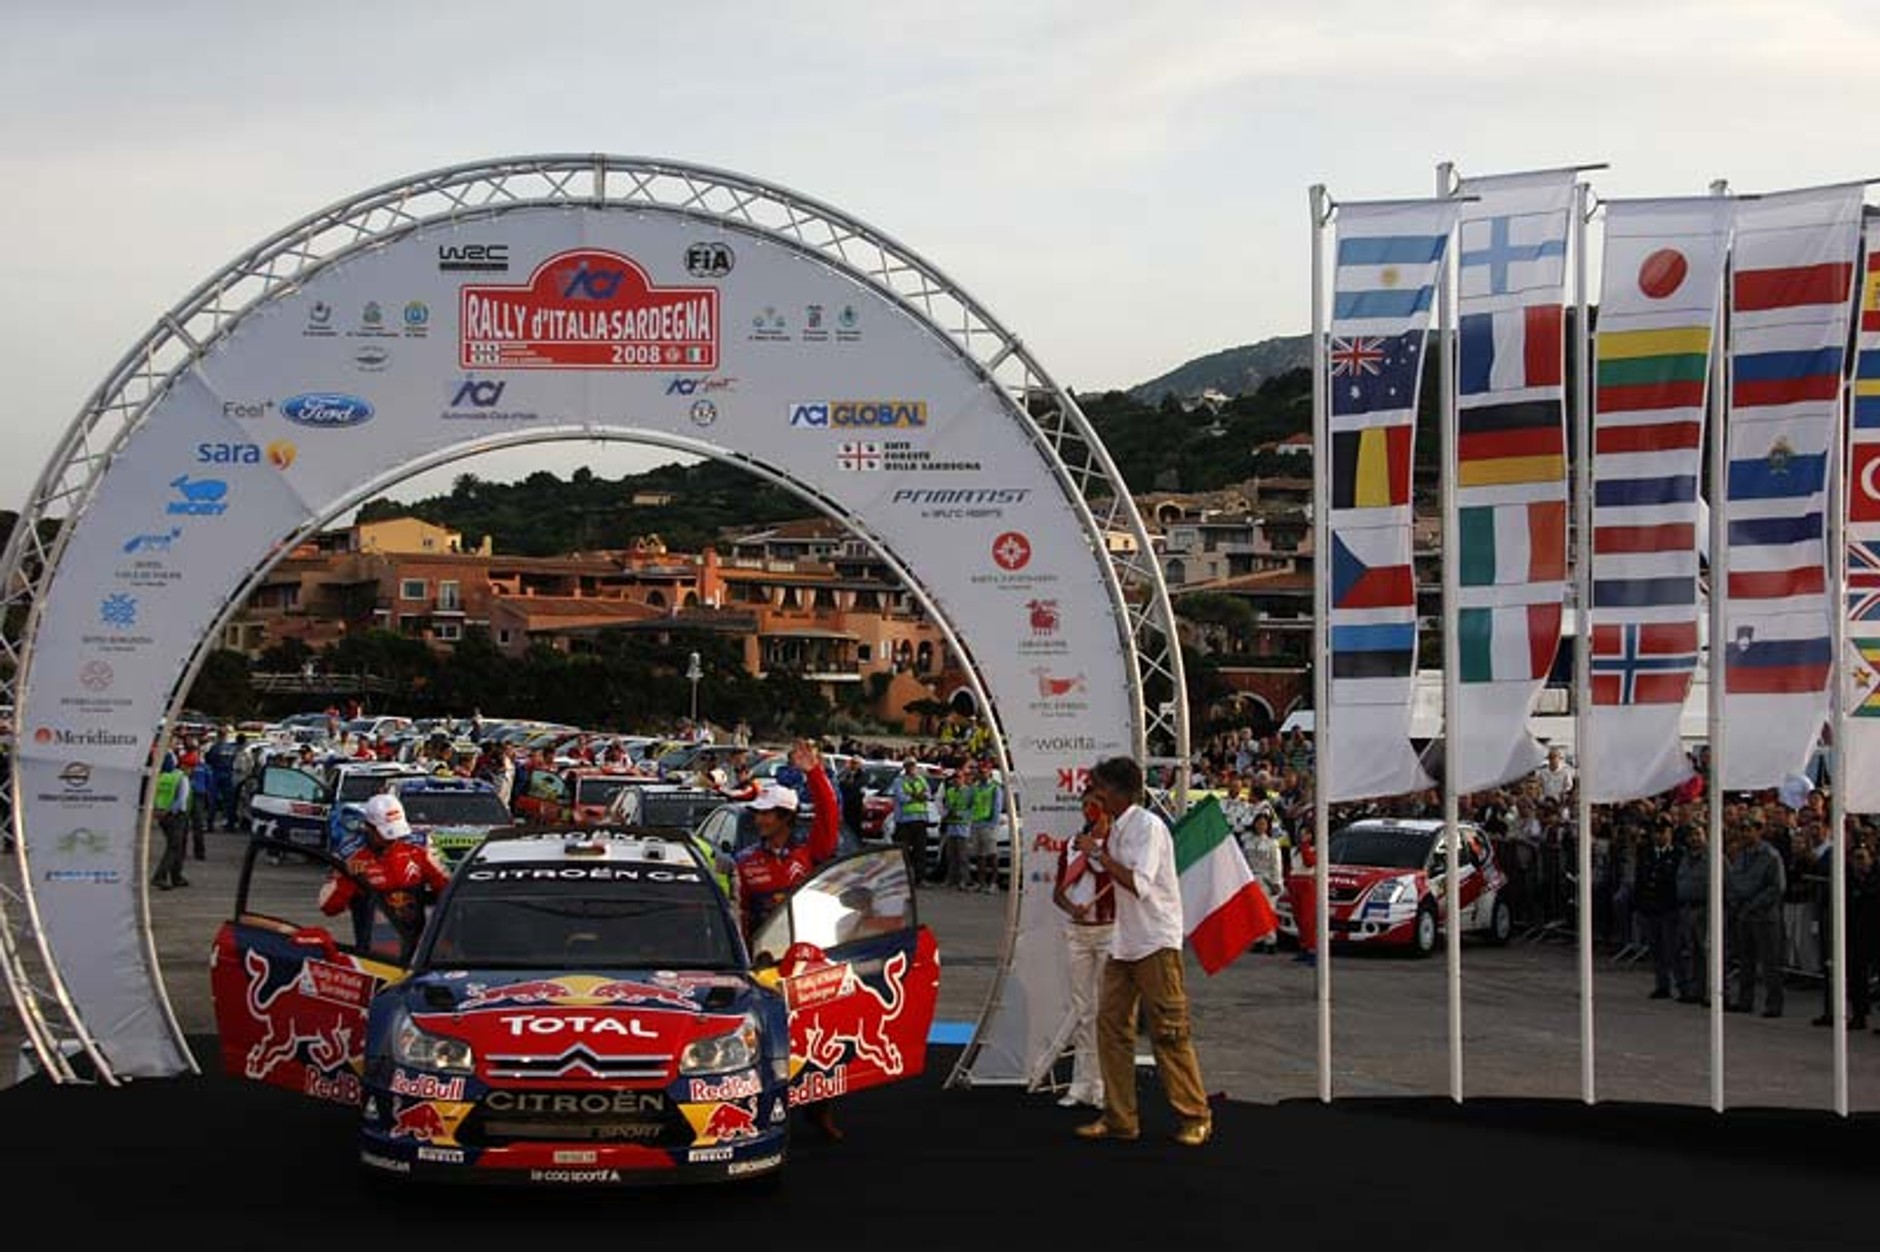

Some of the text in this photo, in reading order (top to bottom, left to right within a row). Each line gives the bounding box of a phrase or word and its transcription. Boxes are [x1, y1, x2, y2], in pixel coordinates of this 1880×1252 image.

[439, 245, 508, 260] WRC
[466, 295, 526, 339] RALLY
[612, 345, 660, 364] 2008
[451, 381, 506, 407] ACI
[666, 379, 699, 395] ACI
[299, 401, 353, 421] Ford
[791, 405, 926, 425] ACI GLOBAL
[198, 443, 260, 464] sara
[921, 462, 981, 471] SARDEGNA
[892, 488, 1031, 504] PRIMATIST
[55, 728, 138, 747] Meridiana
[468, 866, 701, 882] CITROËN C4
[500, 1014, 660, 1038] TOTAL
[788, 1064, 848, 1103] ed Bull
[486, 1089, 665, 1113] CITROËN
